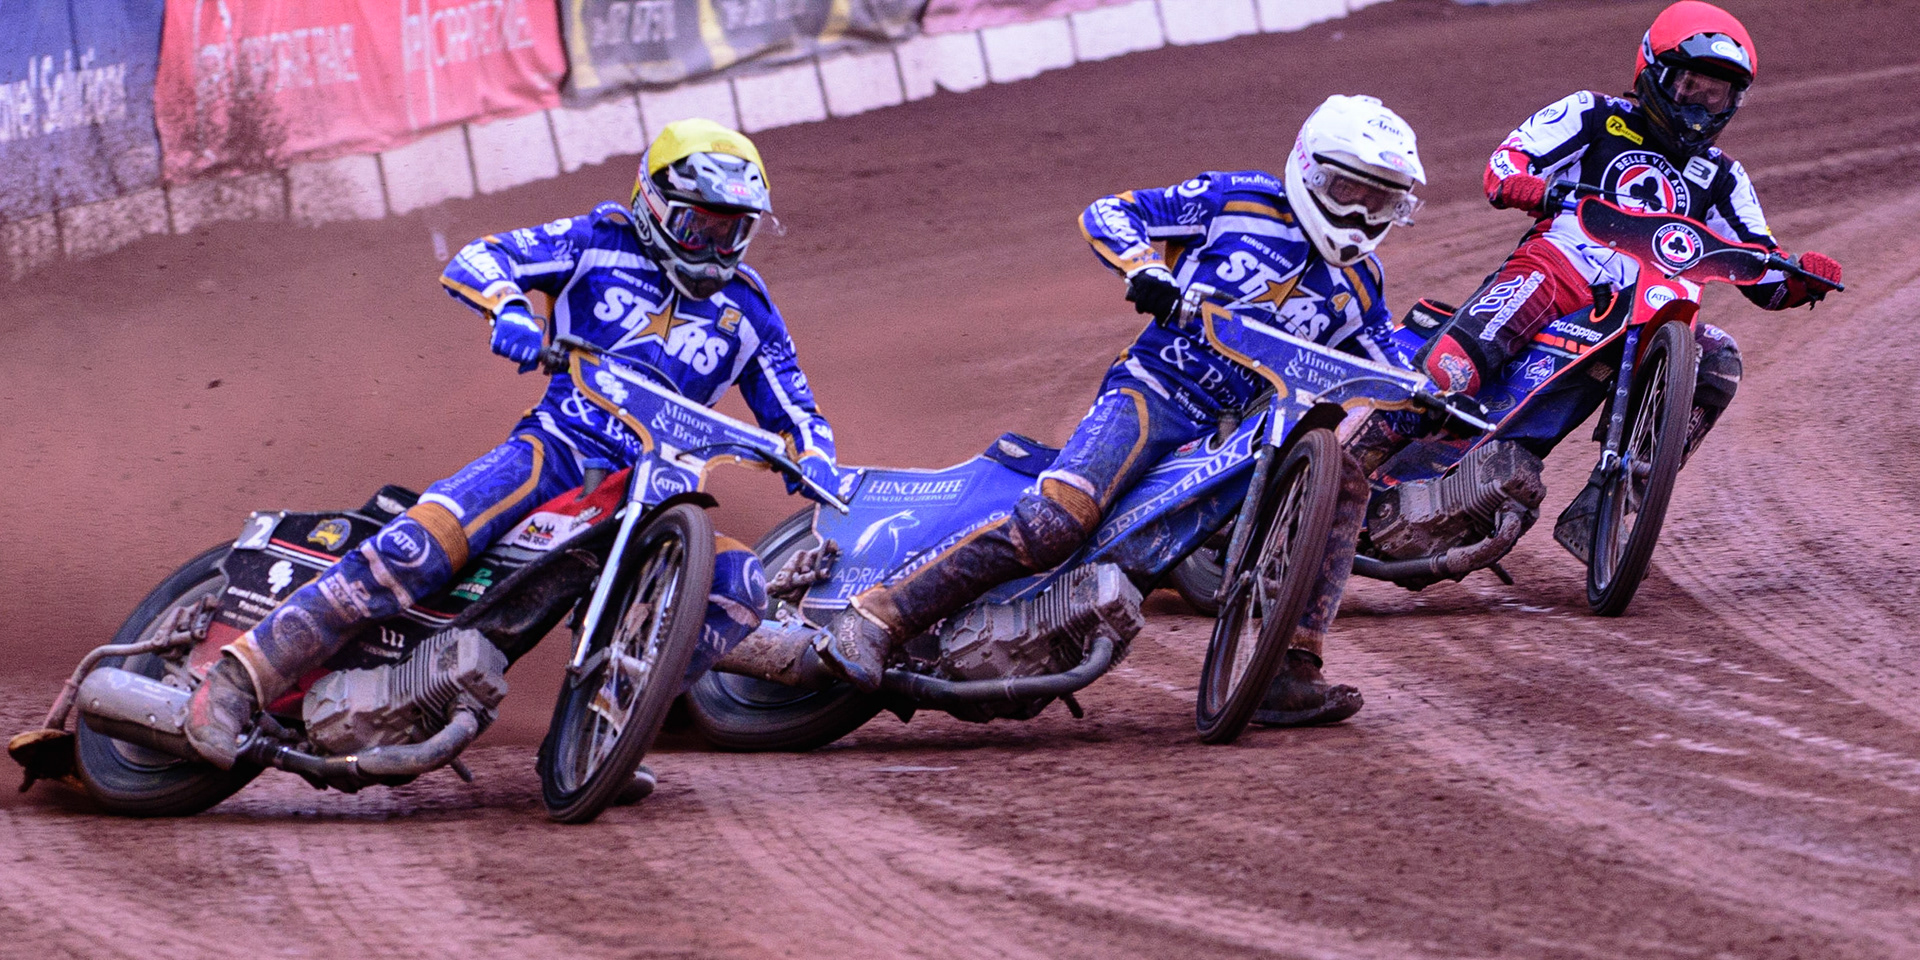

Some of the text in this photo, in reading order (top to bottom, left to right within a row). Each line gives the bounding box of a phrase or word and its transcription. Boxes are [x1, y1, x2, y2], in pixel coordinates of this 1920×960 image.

[1615, 155, 1686, 208] BELLE VUE ACES
[718, 307, 742, 333] 2
[1160, 337, 1199, 370] &
[1294, 348, 1347, 375] Minors
[1284, 360, 1304, 379] &
[560, 387, 599, 426] &
[660, 400, 713, 434] Minors
[651, 410, 671, 433] &
[673, 423, 713, 455] Brady
[1183, 443, 1243, 491] FLUX
[656, 477, 685, 494] ATPI
[868, 479, 966, 495] HINCHLIFFE
[241, 516, 273, 549] 2
[387, 530, 420, 558] ATPI
[832, 567, 886, 583] ADRIA
